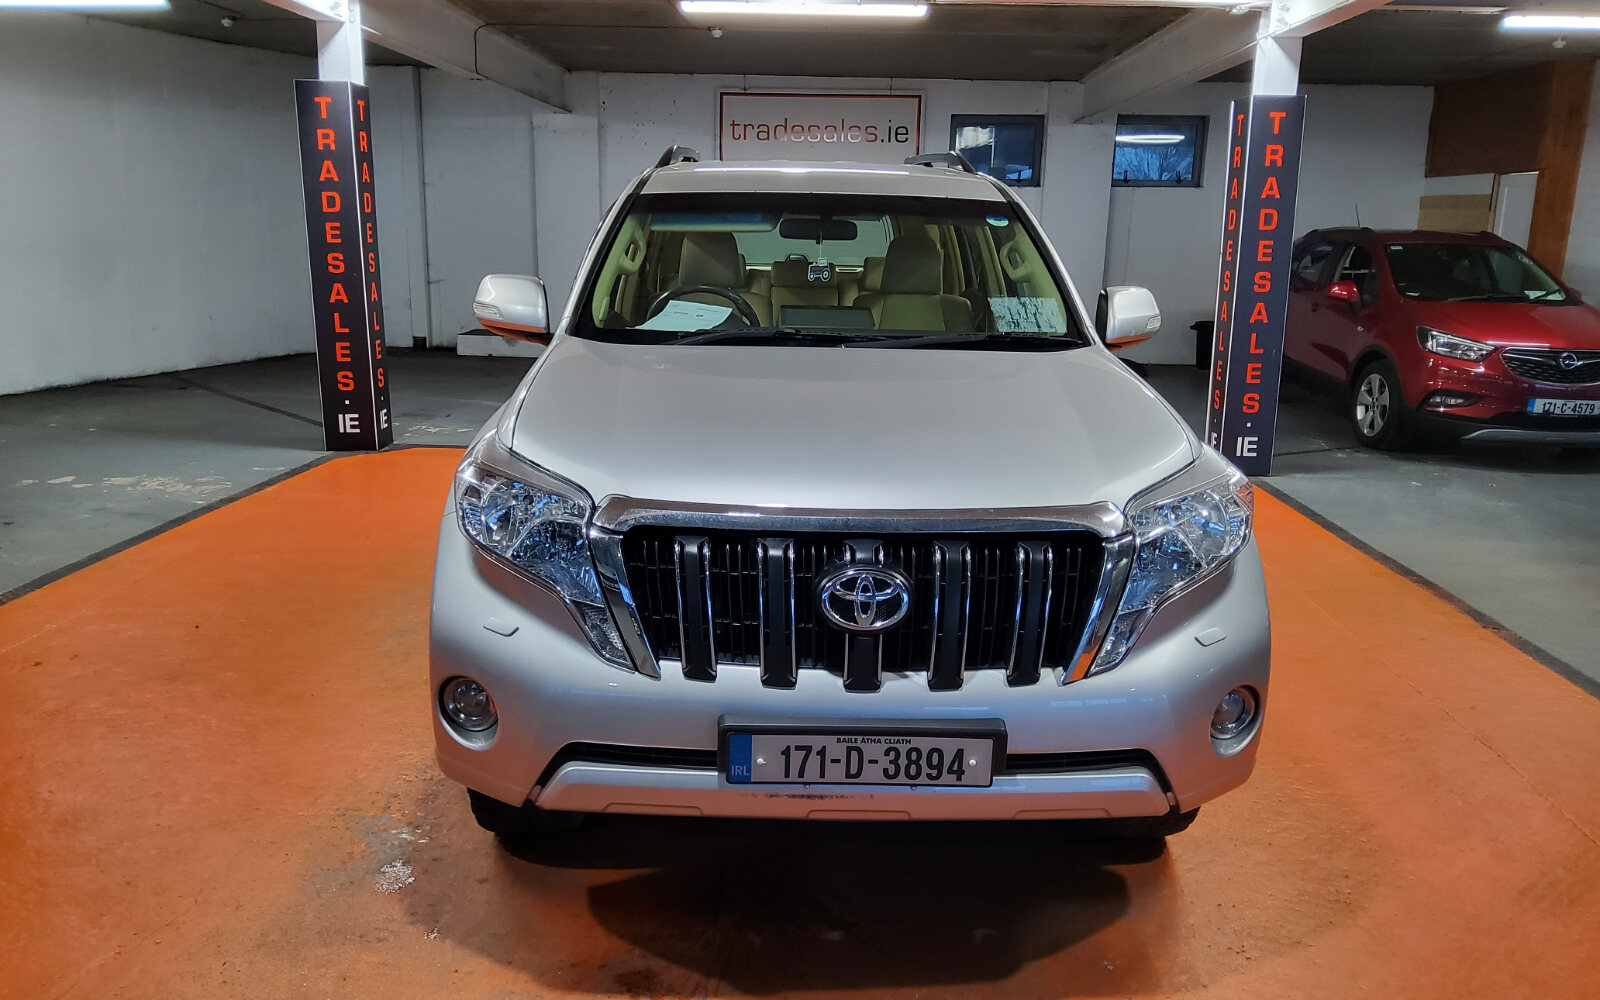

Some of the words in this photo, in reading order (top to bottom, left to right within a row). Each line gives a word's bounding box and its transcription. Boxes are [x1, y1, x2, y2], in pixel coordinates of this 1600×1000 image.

[729, 117, 909, 144] tradesales.ie
[1542, 401, 1596, 414] 171-C-4579
[836, 737, 858, 745] BAILE
[780, 744, 966, 782] 171-D-3894
[731, 765, 750, 776] IRL
